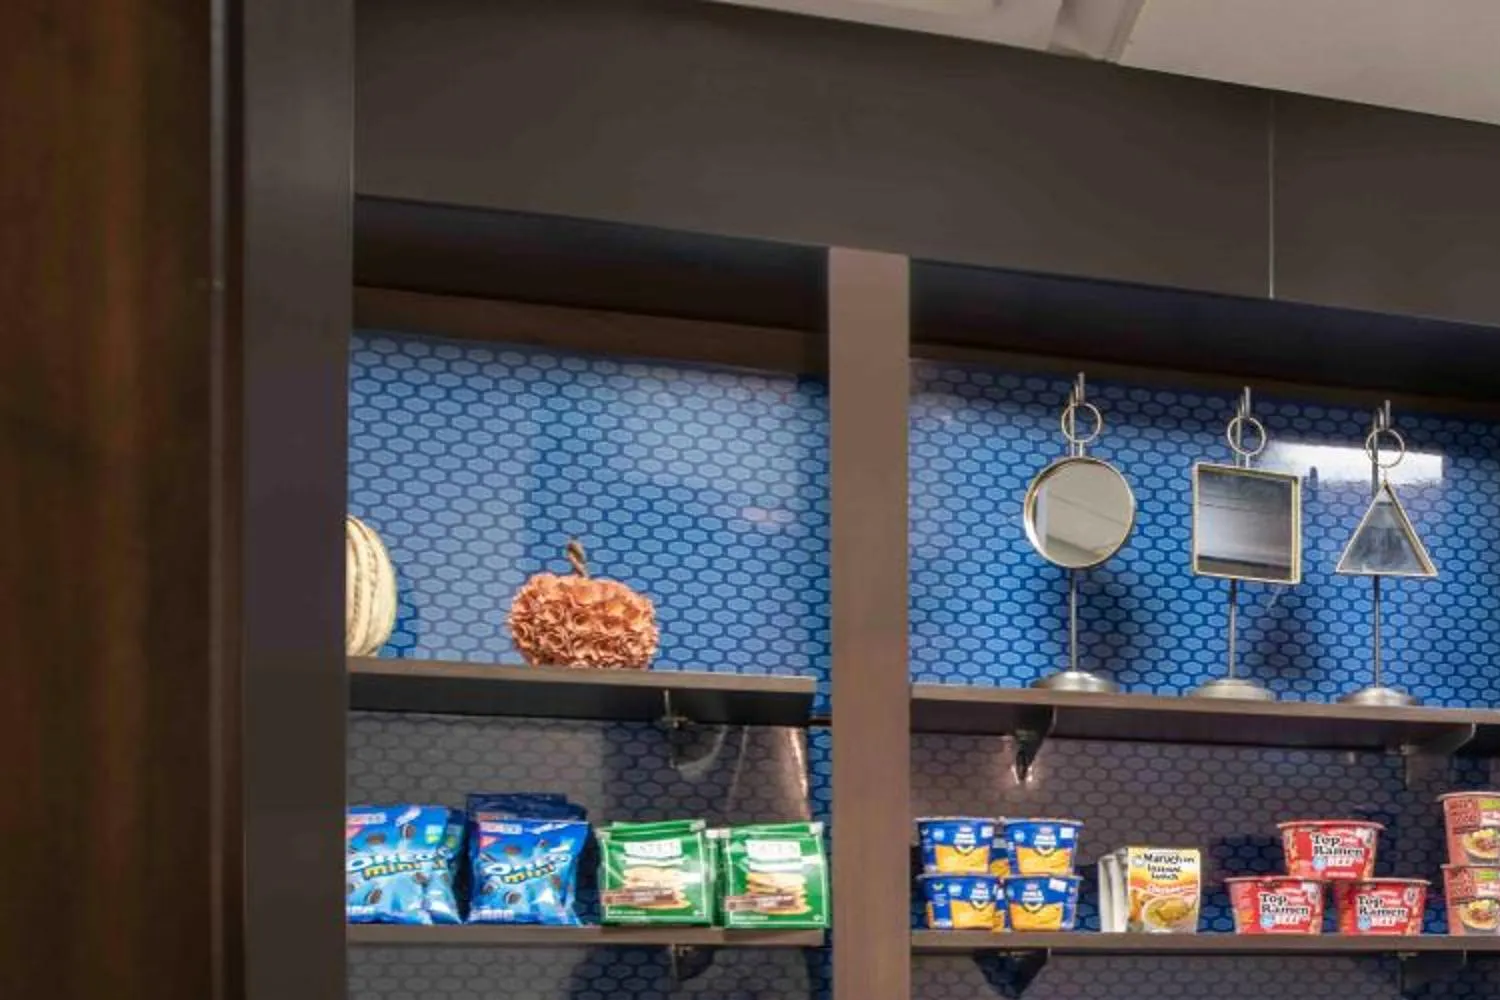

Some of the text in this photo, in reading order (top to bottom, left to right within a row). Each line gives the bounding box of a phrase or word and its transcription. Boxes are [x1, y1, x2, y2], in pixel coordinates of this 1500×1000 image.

[1313, 834, 1340, 847] Top
[1313, 846, 1362, 855] Ramen
[1260, 893, 1287, 906] Top
[1262, 904, 1309, 916] Ramen
